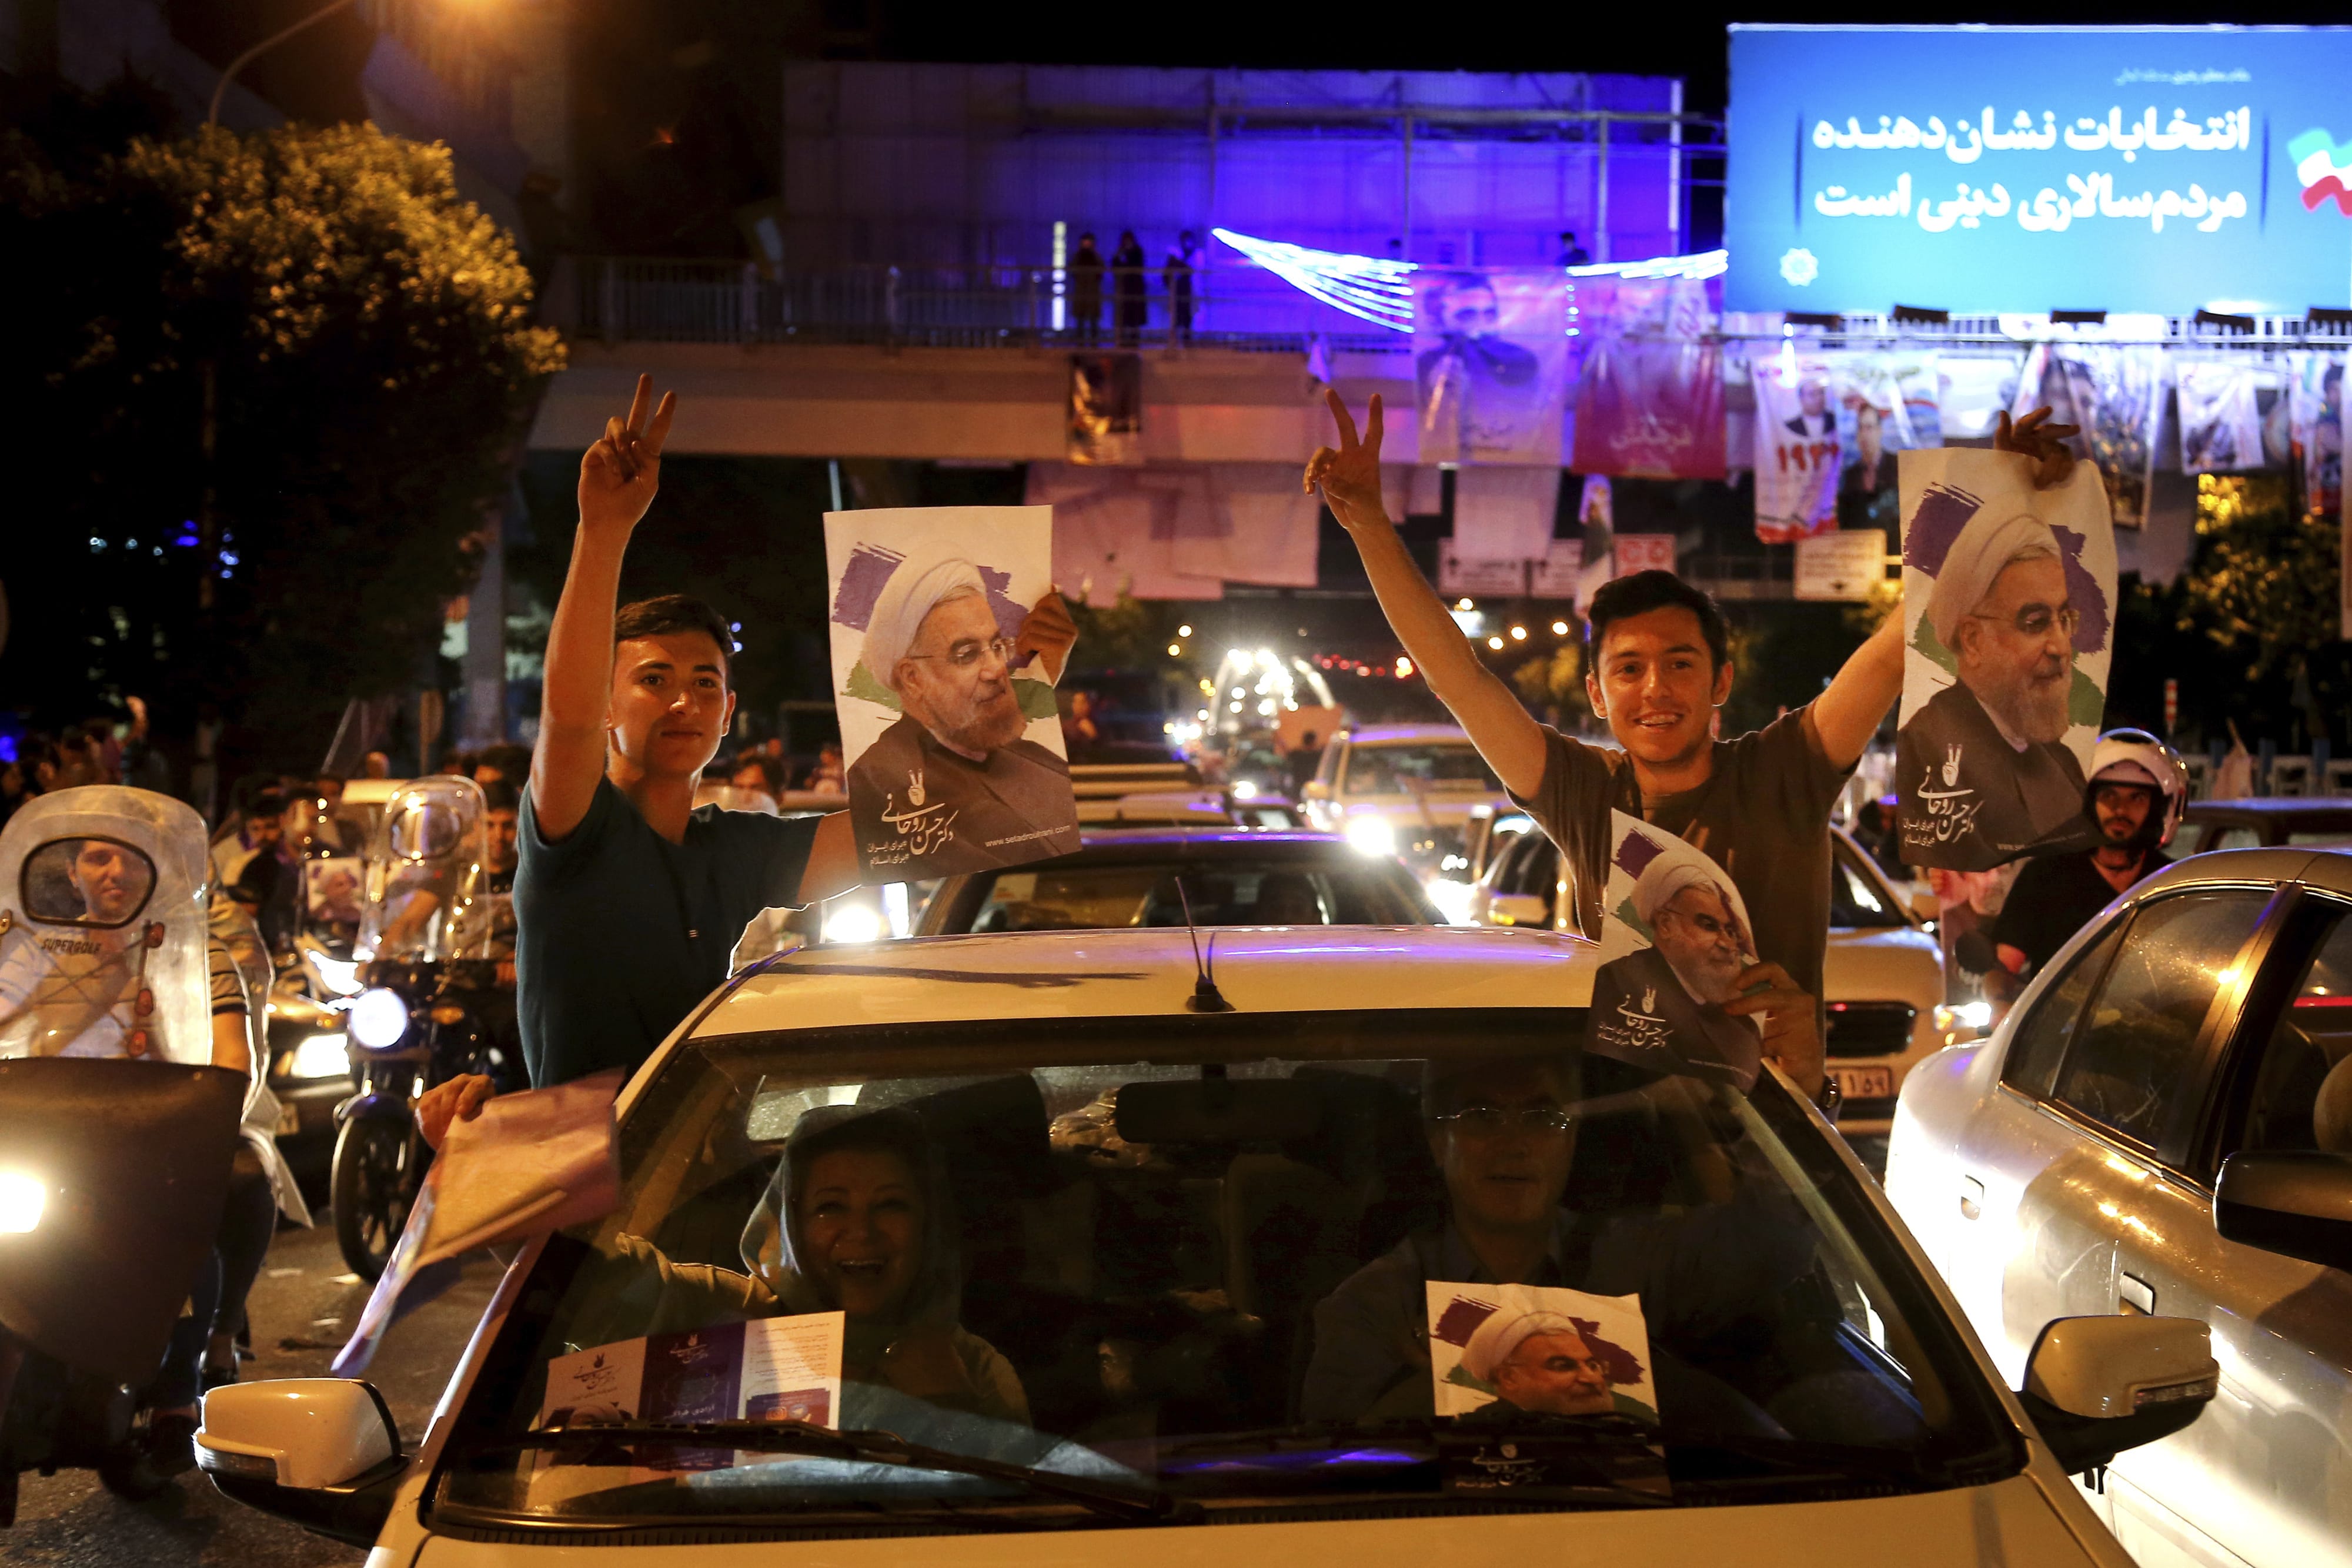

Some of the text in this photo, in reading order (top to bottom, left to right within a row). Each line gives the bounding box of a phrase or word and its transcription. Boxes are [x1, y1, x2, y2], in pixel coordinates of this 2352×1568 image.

[2064, 106, 2251, 162] انتخابات
[1814, 172, 1912, 218] است
[1917, 182, 2011, 233] دینی
[1917, 765, 1974, 815] روحانی
[881, 793, 960, 855] دکتر حسن روحانی
[1936, 804, 1970, 841] حسن
